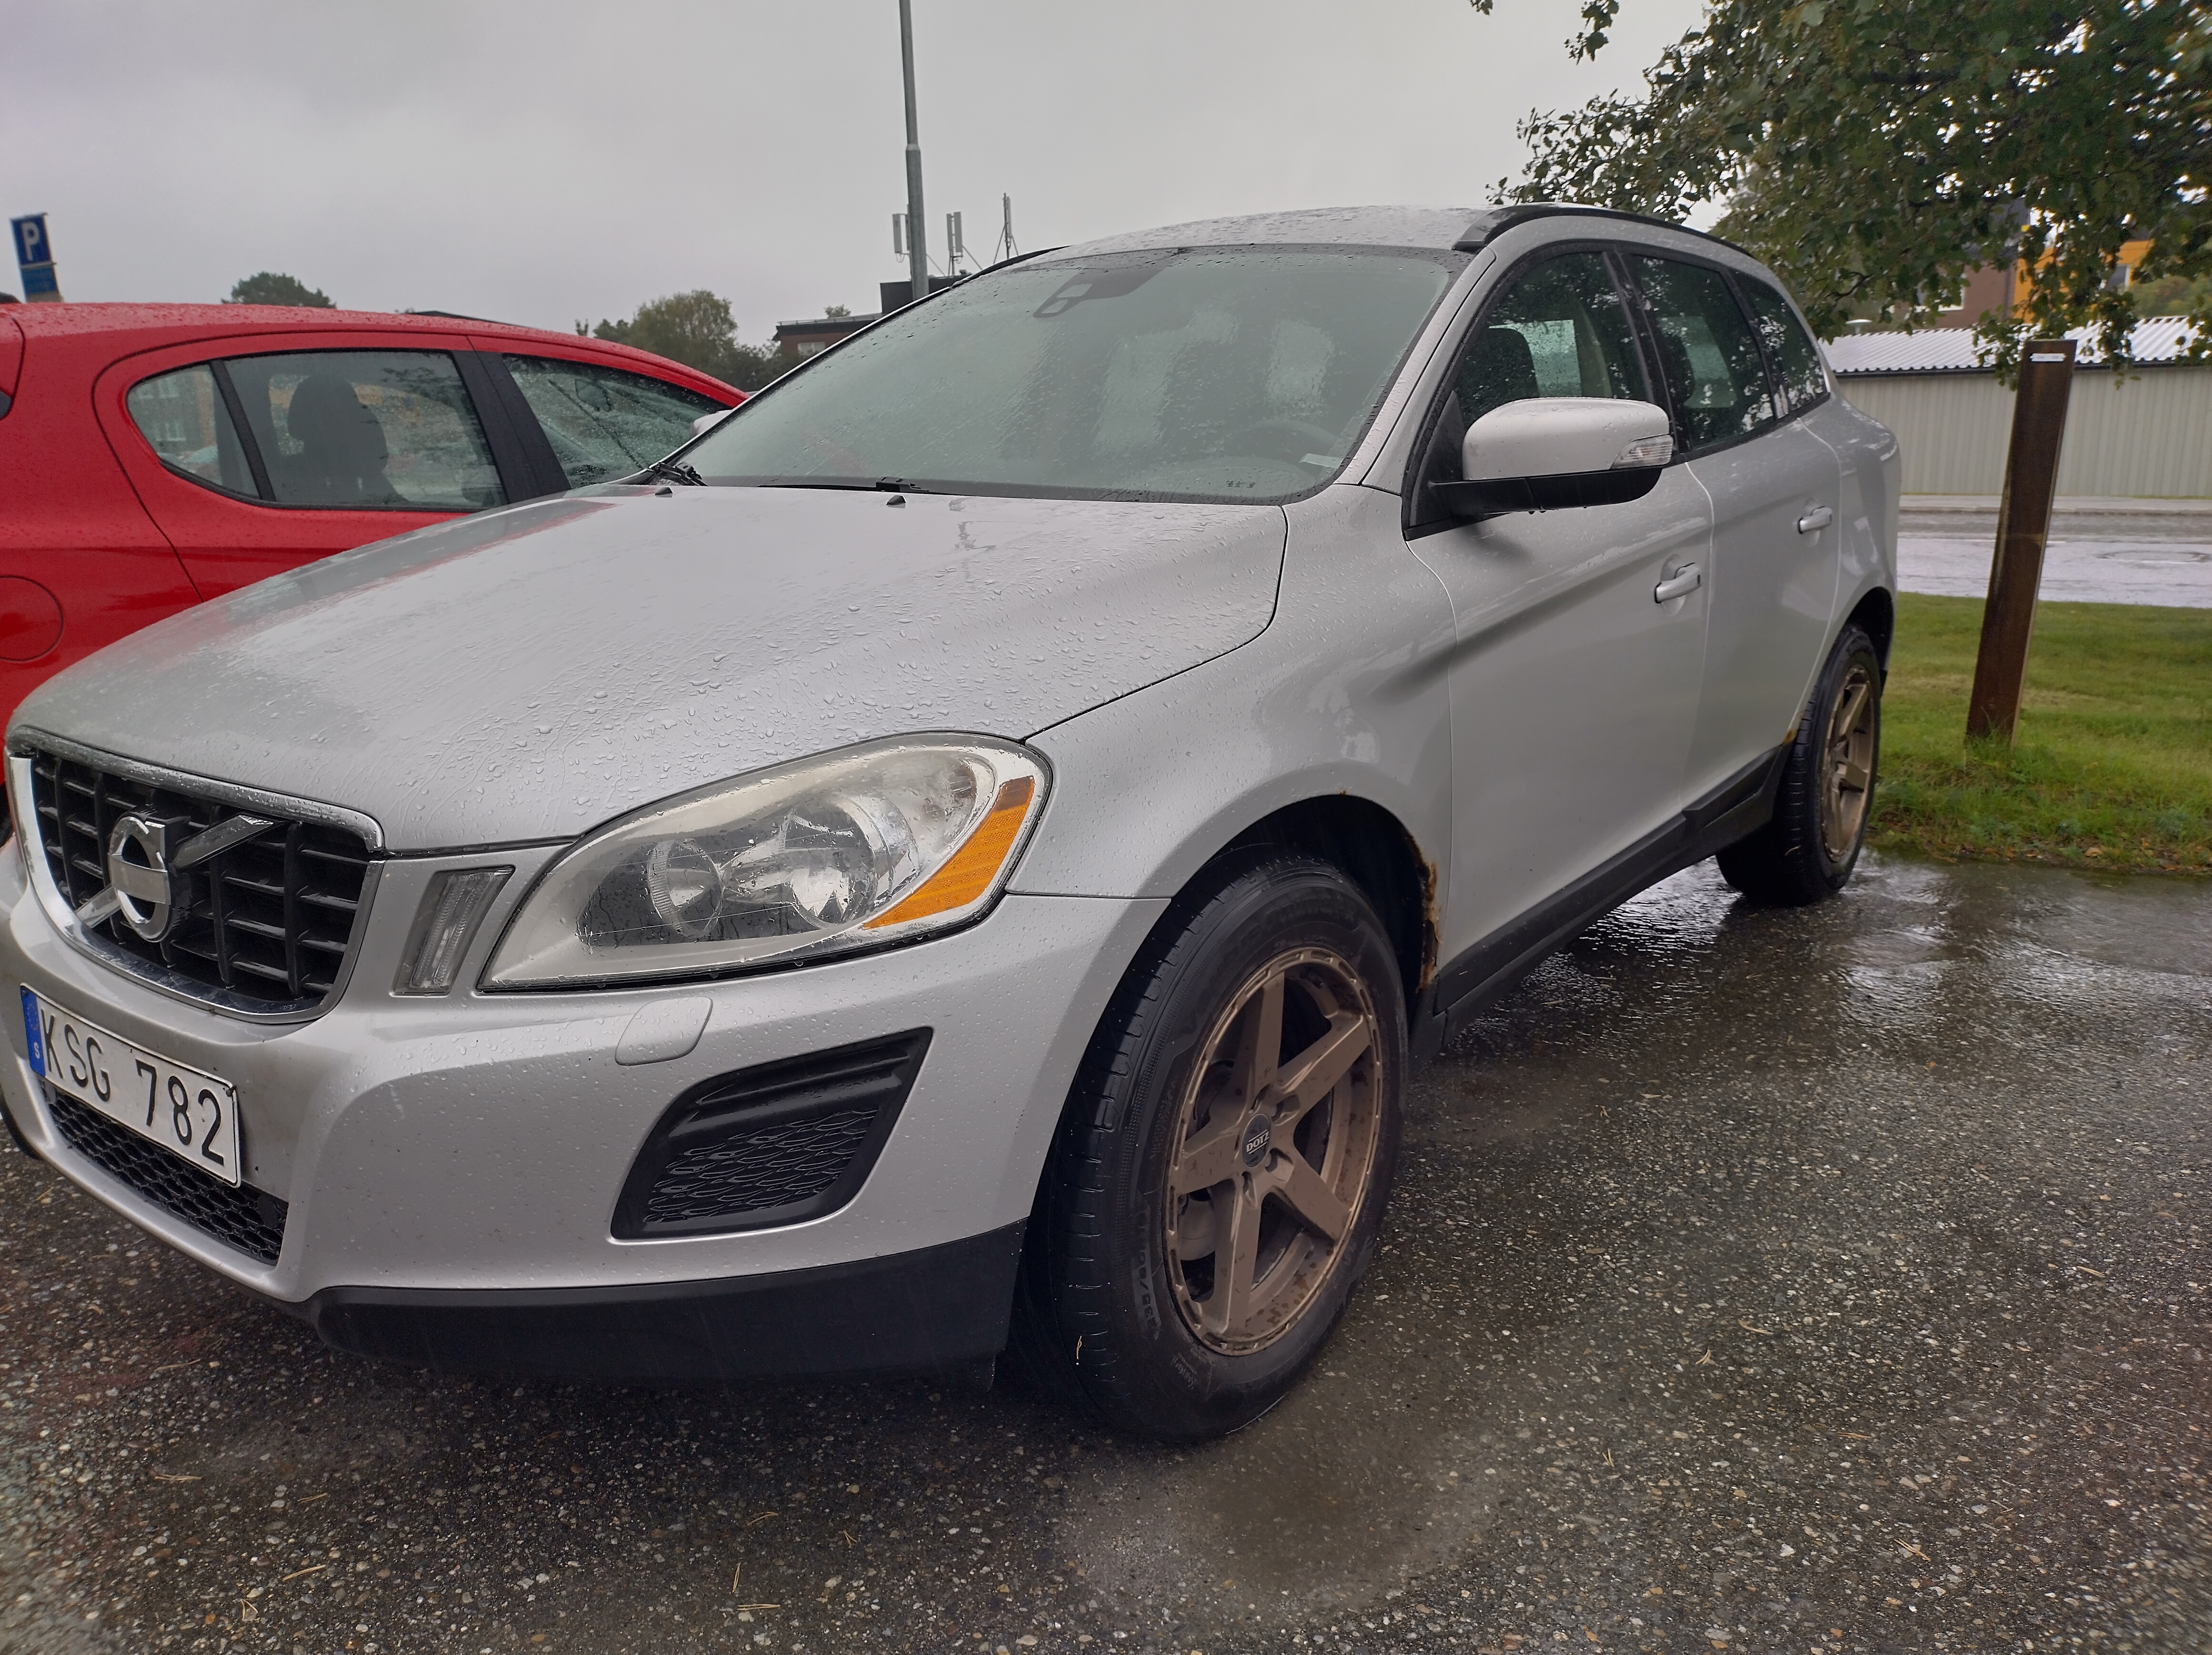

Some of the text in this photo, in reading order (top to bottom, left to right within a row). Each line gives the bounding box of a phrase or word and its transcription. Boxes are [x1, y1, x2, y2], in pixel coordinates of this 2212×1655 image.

[21, 221, 40, 261] P
[33, 1042, 40, 1059] S
[41, 1008, 224, 1166] KSG 782
[1246, 1131, 1270, 1152] DOTZ
